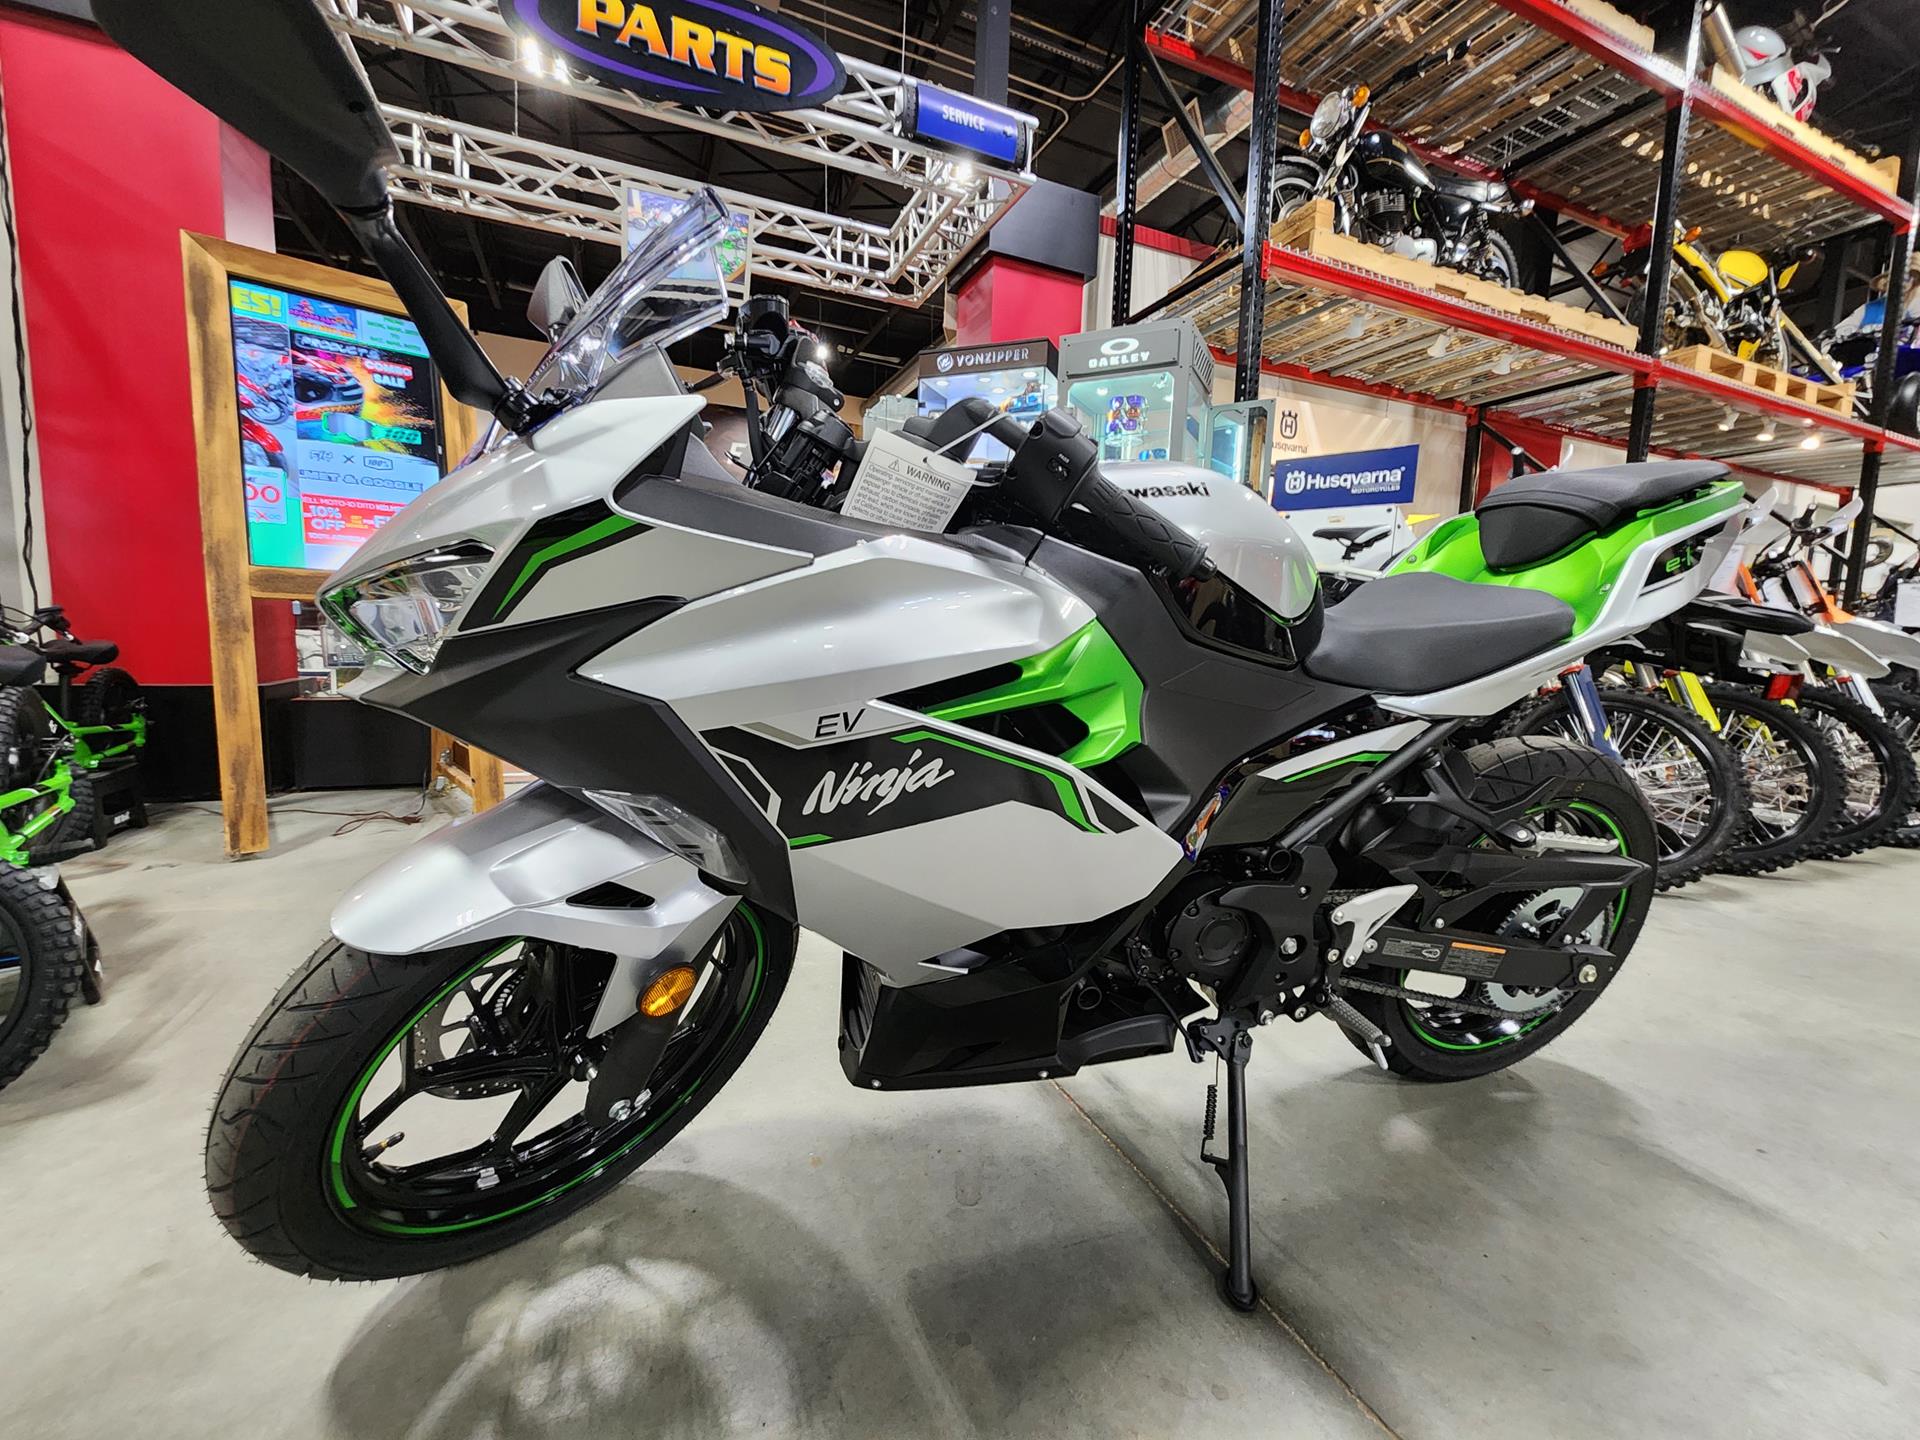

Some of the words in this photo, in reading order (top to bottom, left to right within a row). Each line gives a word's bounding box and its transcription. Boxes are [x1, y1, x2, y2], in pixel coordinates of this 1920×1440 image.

[577, 0, 792, 96] PARTS
[942, 104, 985, 132] SERVICE
[956, 347, 1030, 368] VONZIPPER
[1088, 351, 1150, 369] OAKLEY
[373, 373, 407, 389] SALE
[1272, 441, 1307, 454] usqvarna
[906, 465, 951, 491] WARNING
[1306, 468, 1402, 490] Husqvarna
[1126, 481, 1211, 499] wasaki
[1351, 484, 1401, 494] MOTORCYCLES
[309, 505, 342, 519] 10%
[311, 518, 346, 531] OFF
[814, 708, 866, 739] EV
[802, 748, 955, 816] Ninja
